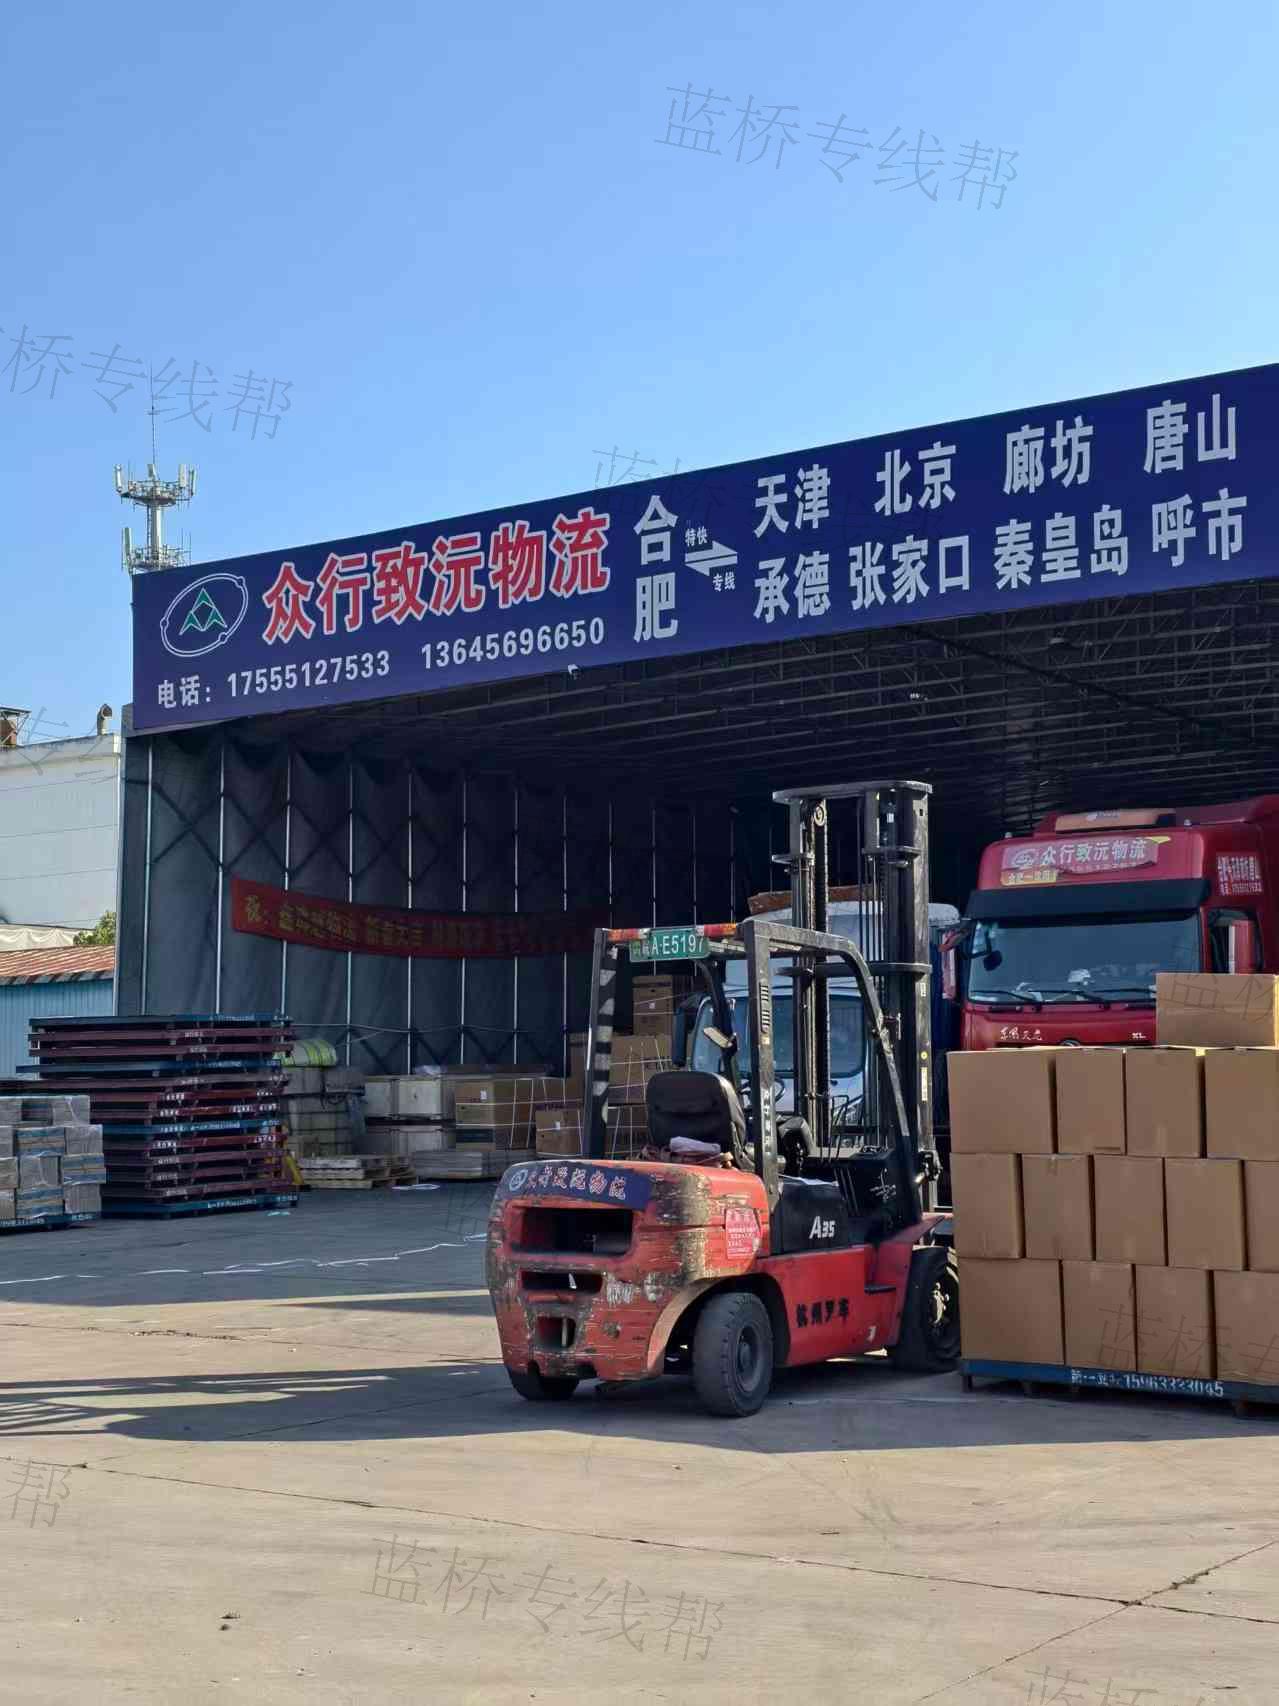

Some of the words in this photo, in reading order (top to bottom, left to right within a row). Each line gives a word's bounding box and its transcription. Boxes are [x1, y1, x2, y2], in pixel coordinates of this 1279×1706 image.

[753, 463, 831, 539] 天津
[874, 441, 957, 517] 北京
[1003, 415, 1094, 496] 廊坊
[1144, 393, 1237, 474] 唐山
[261, 507, 611, 646] 众行致沅物流
[712, 571, 736, 592] 专线
[753, 550, 832, 625] 承德
[849, 534, 972, 611] 张家口
[993, 503, 1129, 591] 秦皇岛
[1151, 487, 1248, 567] 呼市
[227, 650, 391, 698] 17555127533
[421, 617, 605, 670] 13645696650
[808, 1215, 837, 1240] A35
